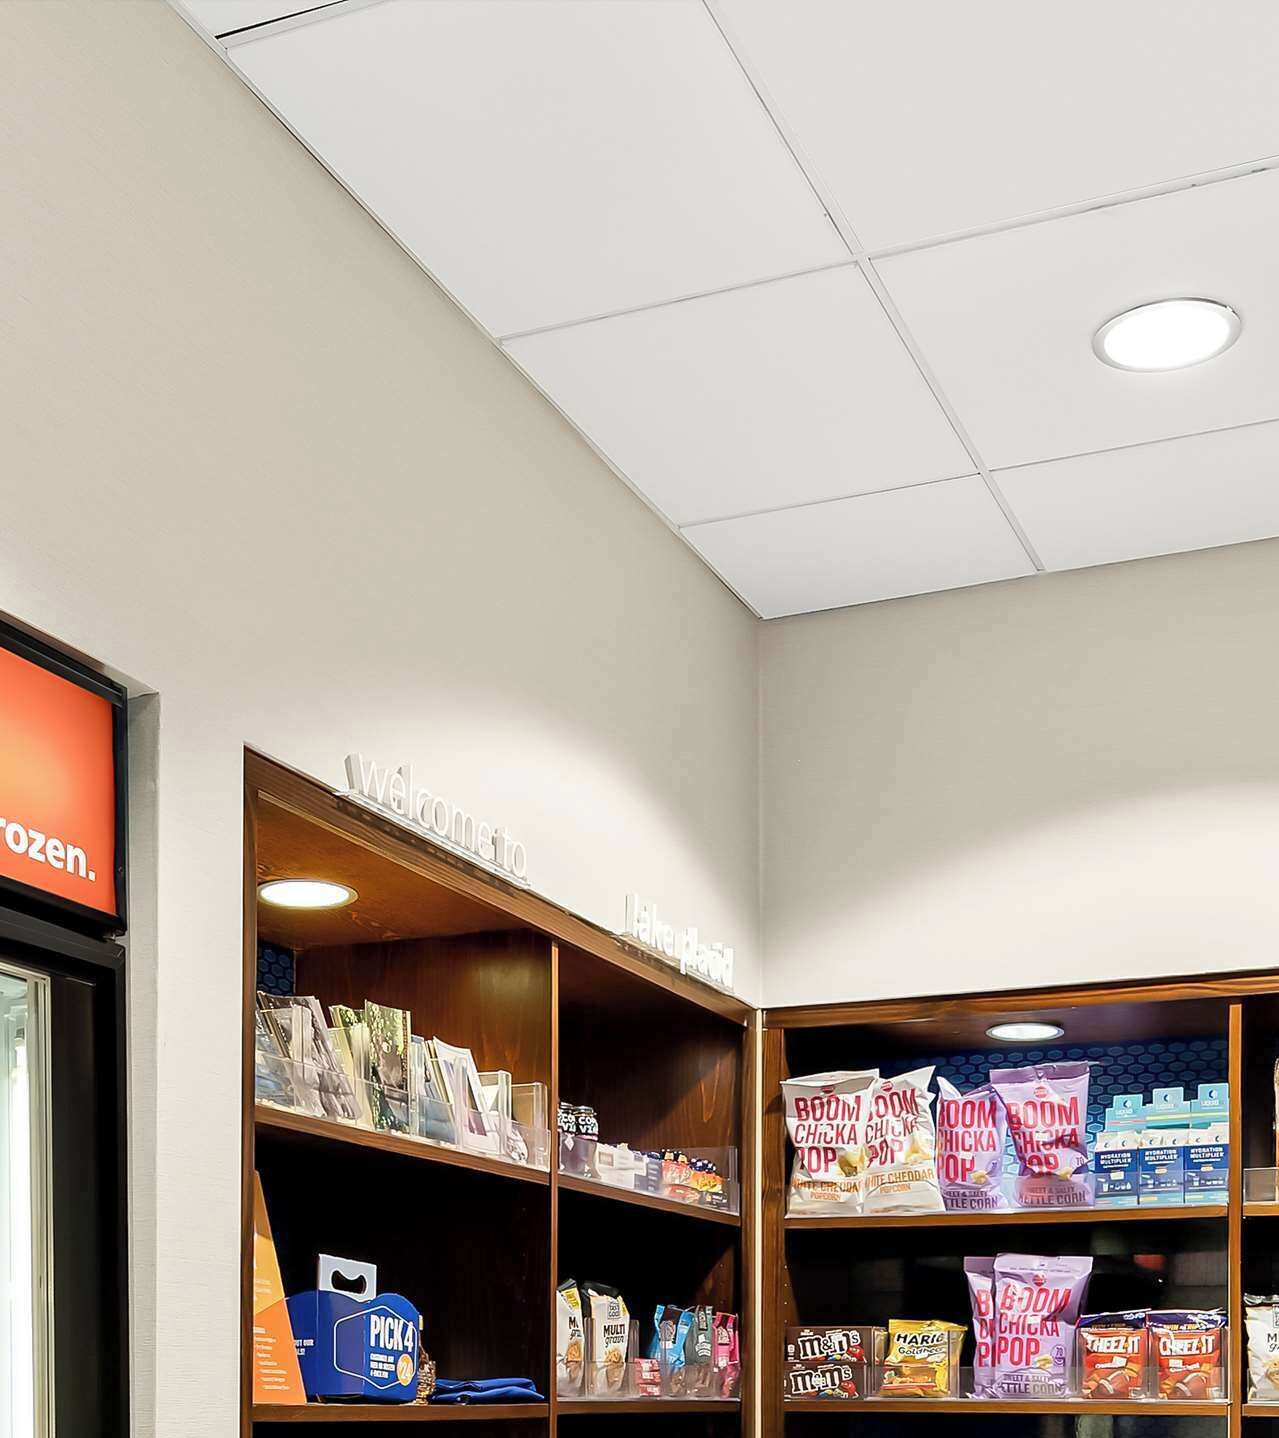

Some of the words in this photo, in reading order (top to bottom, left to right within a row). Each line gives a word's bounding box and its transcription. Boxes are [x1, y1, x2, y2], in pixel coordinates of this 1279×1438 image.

[344, 752, 495, 862] Welcome
[794, 1094, 862, 1122] BOOM
[1006, 1096, 1080, 1131] BOOM
[794, 1123, 858, 1145] CHICKA
[865, 1116, 920, 1144] CHICKA
[866, 1138, 904, 1168] POP
[1100, 1152, 1131, 1160] HYDRATION
[1190, 1151, 1224, 1159] MULTIPLIER
[887, 1168, 935, 1184] CHEDDAR
[879, 1184, 911, 1195] POPCORN
[1057, 1190, 1086, 1206] CORN
[969, 1196, 998, 1209] CORN
[1000, 1284, 1072, 1313] BOOM
[370, 1314, 404, 1351] PICK
[404, 1321, 415, 1353] 4
[602, 1322, 626, 1339] MULTI
[998, 1312, 1061, 1337] CHICKA
[604, 1334, 625, 1348] grain
[997, 1336, 1041, 1367] POP
